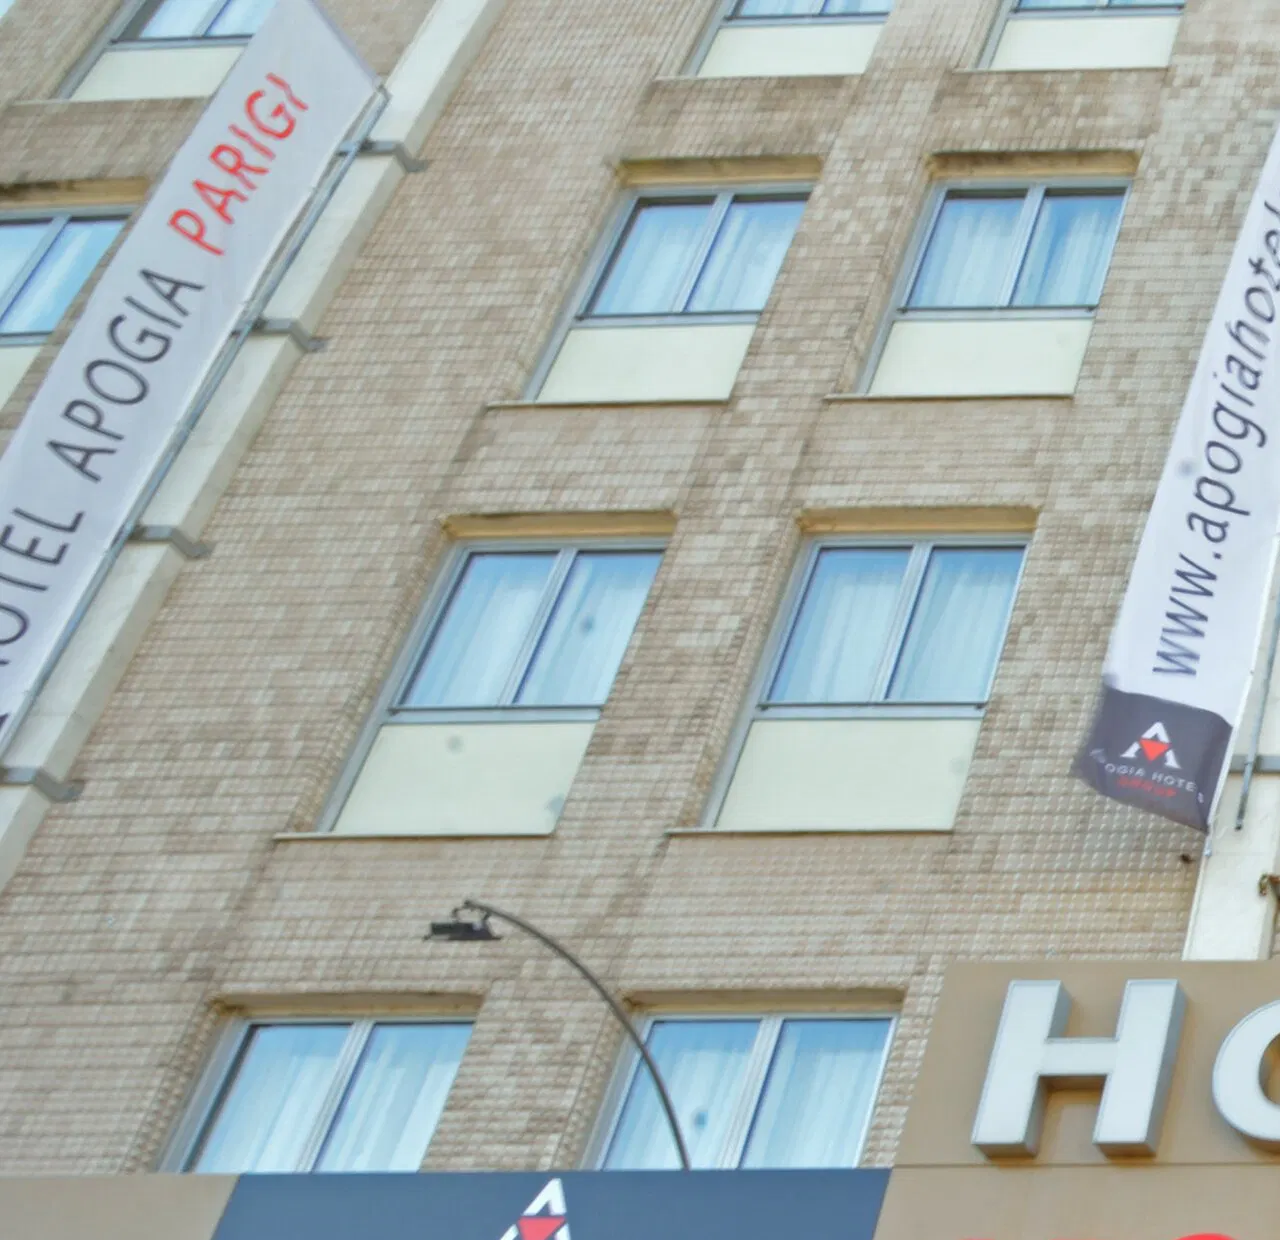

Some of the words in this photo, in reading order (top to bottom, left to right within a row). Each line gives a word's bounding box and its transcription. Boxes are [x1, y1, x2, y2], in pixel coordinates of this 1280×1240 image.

[0, 507, 85, 666] OTEL
[45, 267, 206, 484] APOGIA
[167, 72, 309, 257] PARIGI
